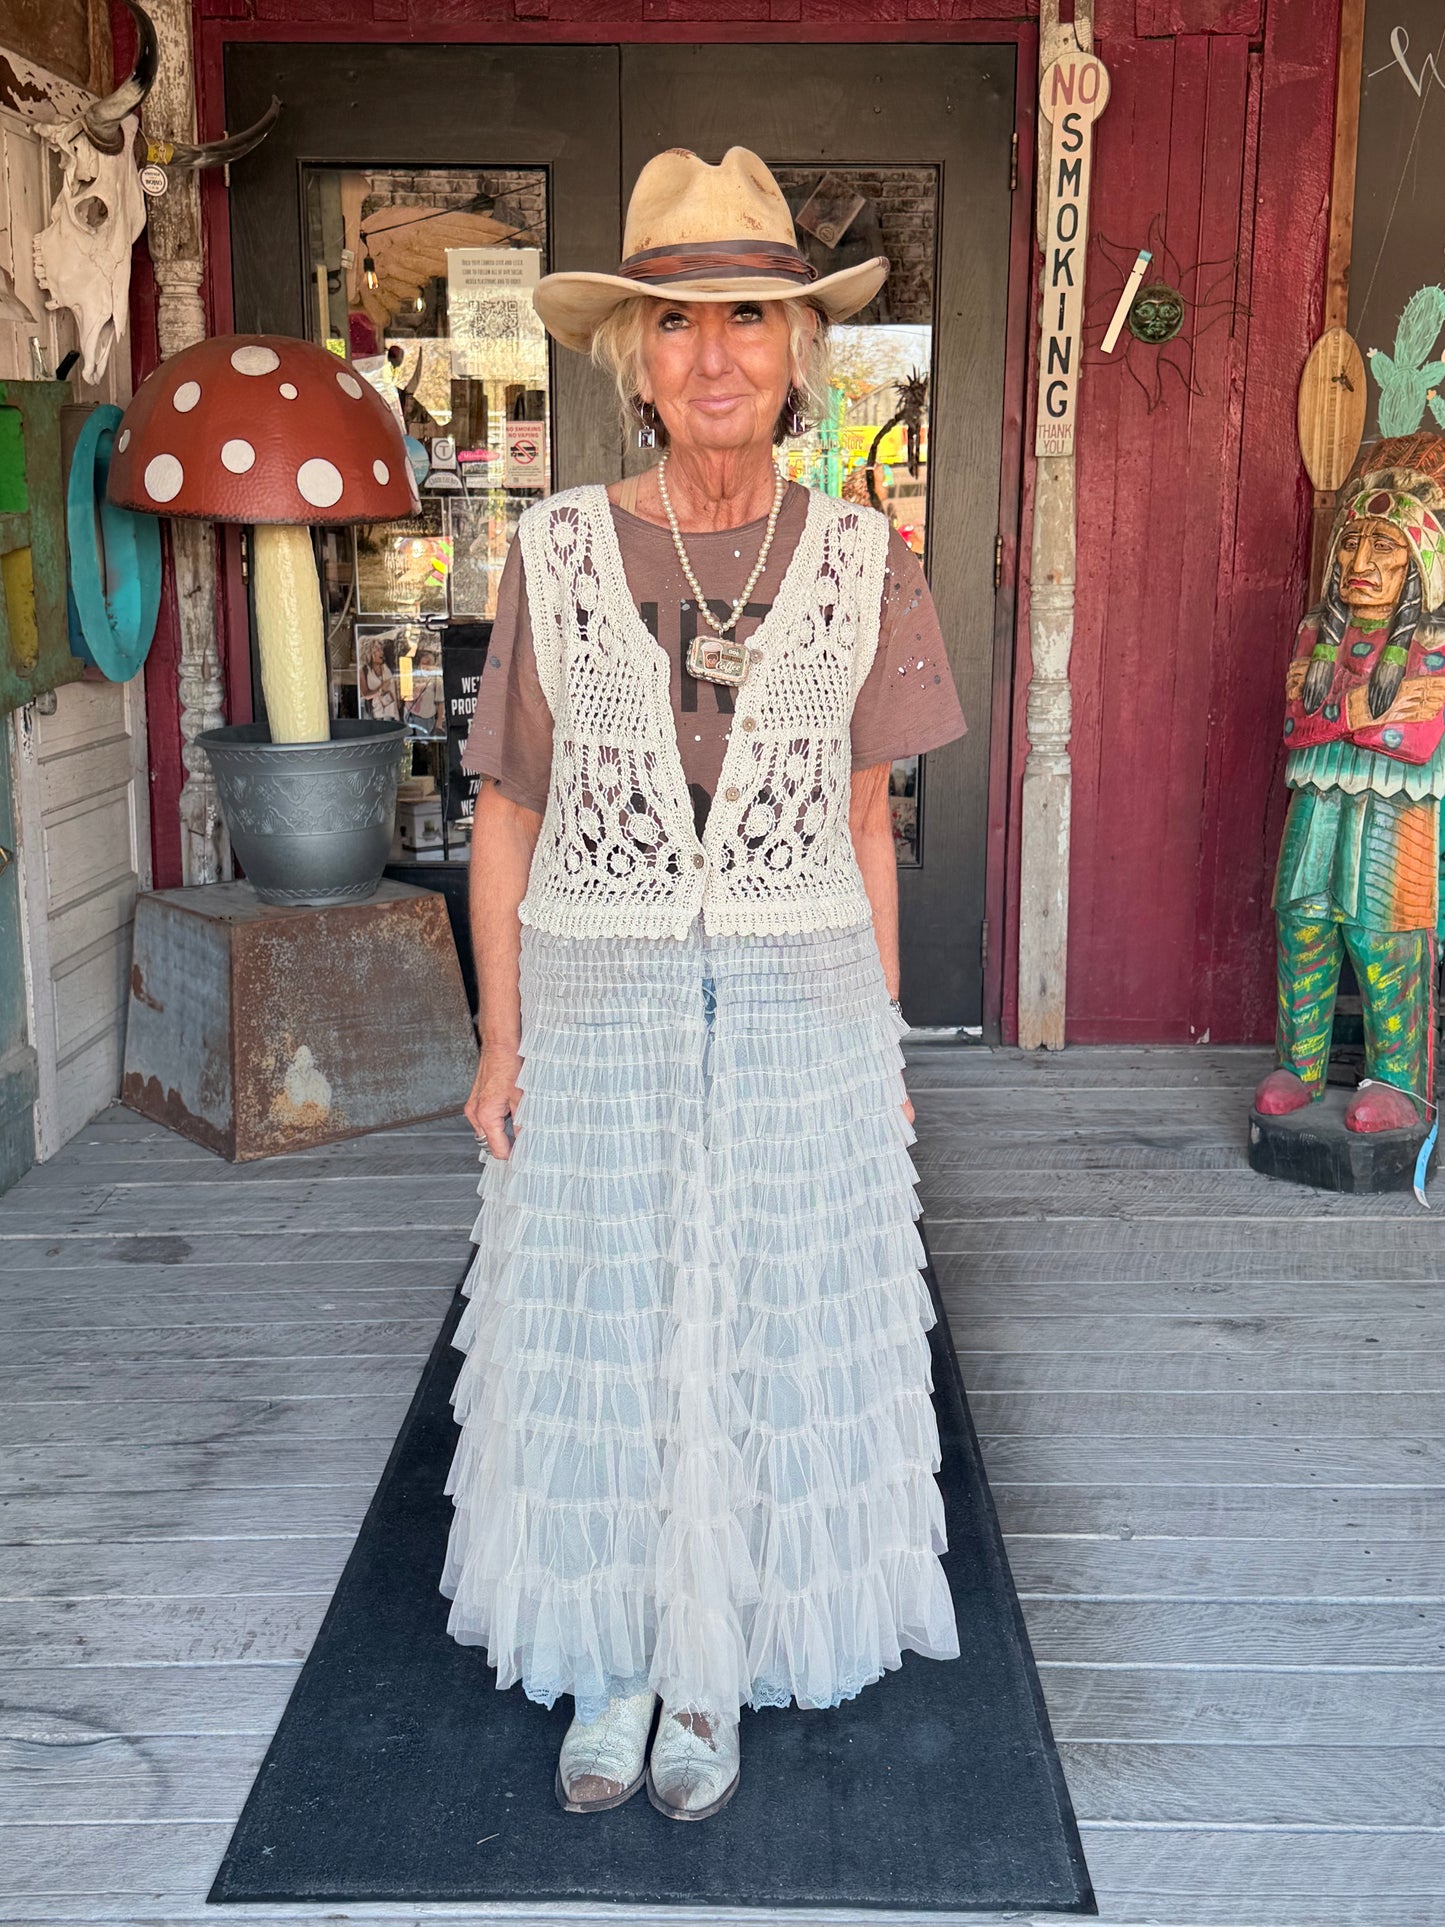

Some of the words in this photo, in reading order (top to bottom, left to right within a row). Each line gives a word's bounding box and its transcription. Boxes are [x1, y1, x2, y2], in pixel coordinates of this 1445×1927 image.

[1051, 62, 1099, 106] NO
[1046, 112, 1084, 418] SMOKING
[1038, 424, 1072, 439] THANK
[842, 433, 864, 450] Store
[1044, 440, 1064, 454] YOU
[715, 661, 741, 673] Coffee
[461, 676, 482, 694] WE'
